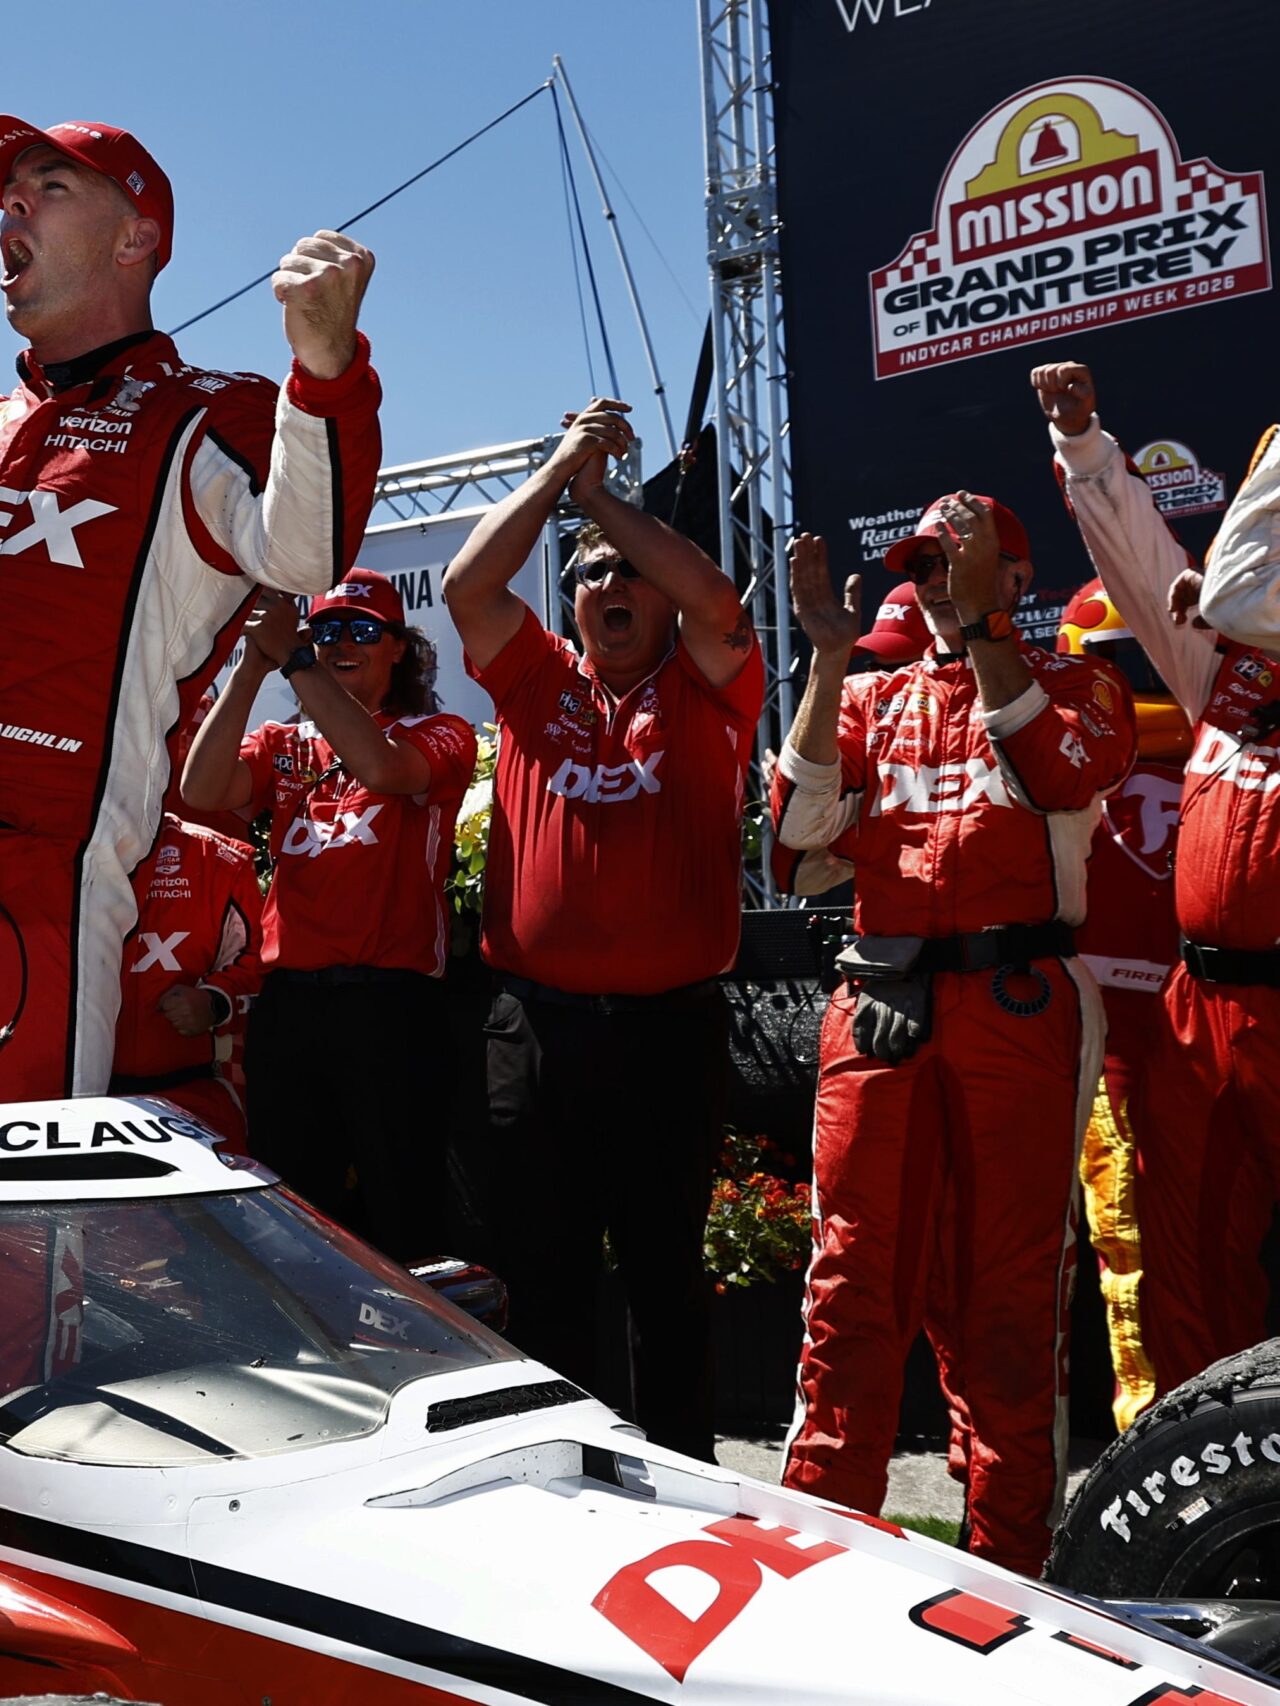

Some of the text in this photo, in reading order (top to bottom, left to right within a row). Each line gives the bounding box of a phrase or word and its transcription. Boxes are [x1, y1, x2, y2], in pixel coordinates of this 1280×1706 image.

[958, 165, 1154, 253] MISSION
[882, 201, 1249, 315] GRAND PRIX
[893, 235, 1240, 337] OF MONTEREY
[899, 274, 1235, 365] INDYCAR CHAMPIONSHIP WEEK 2026
[44, 434, 128, 454] HITACHI
[58, 414, 133, 435] verizon
[325, 582, 374, 600] DEX
[550, 750, 665, 804] DEX
[870, 757, 1014, 817] DEX
[281, 803, 385, 858] DEX
[358, 1302, 412, 1341] DEX
[591, 1511, 850, 1684] DE
